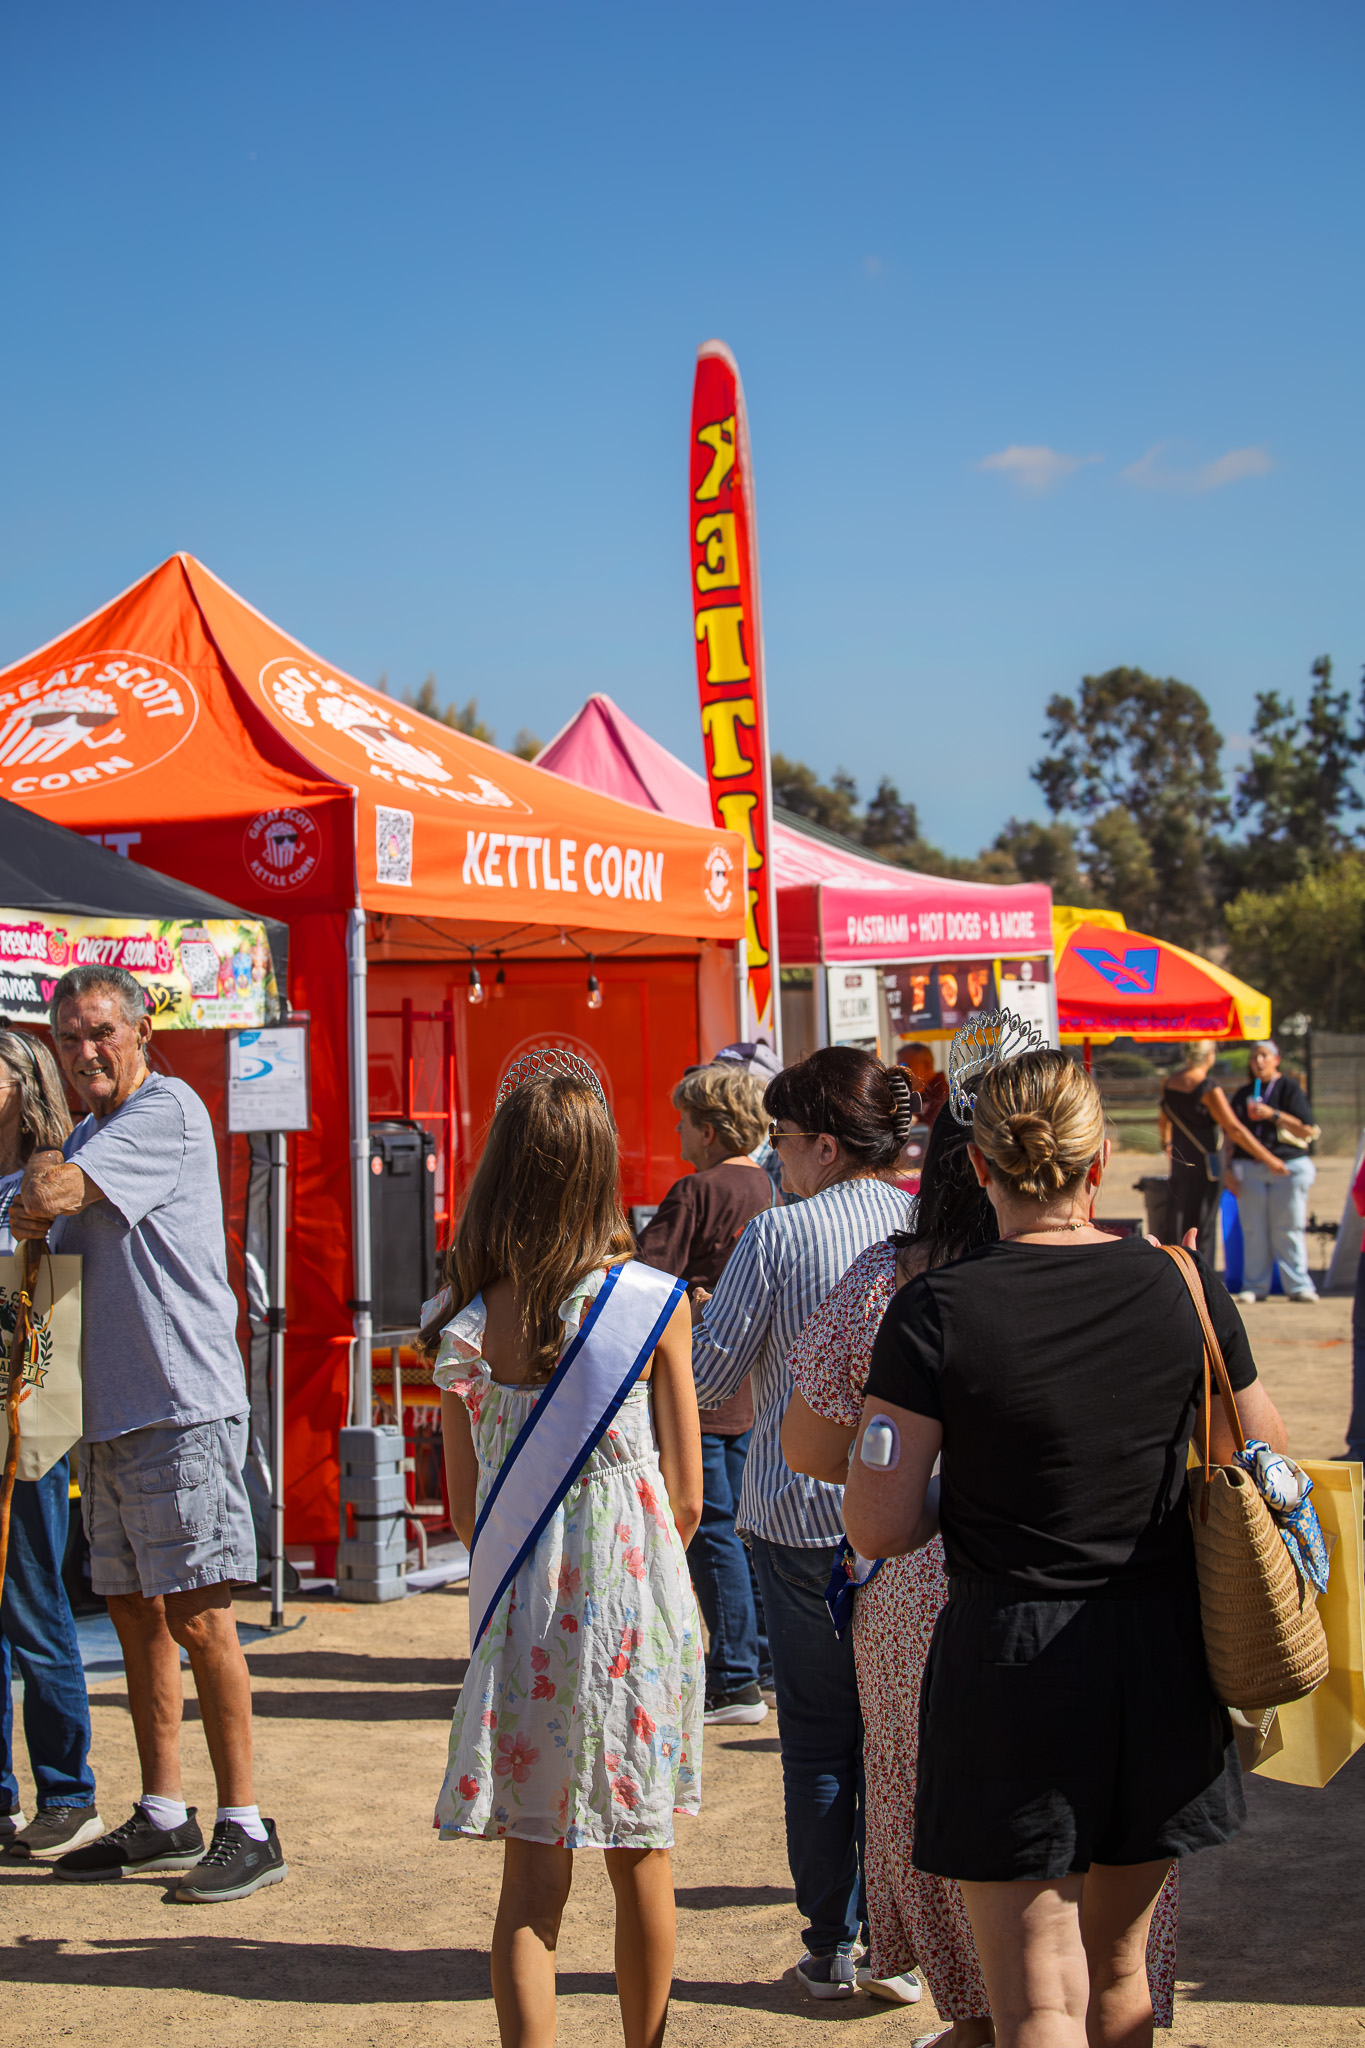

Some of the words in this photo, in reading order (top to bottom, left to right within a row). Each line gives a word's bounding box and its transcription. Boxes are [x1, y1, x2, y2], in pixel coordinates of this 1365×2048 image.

[0, 661, 95, 711] REAT
[94, 660, 184, 718] SCOTT
[11, 755, 134, 793] CORN
[248, 808, 280, 839] GREAT
[282, 807, 315, 834] SCOTT
[250, 859, 287, 887] KETTLE
[288, 855, 315, 884] CORN
[462, 830, 578, 892] KETTLE
[583, 843, 664, 902] CORN
[847, 914, 909, 945] PASTRAMI
[918, 912, 944, 942] HOT
[945, 911, 981, 941] DOGS
[1001, 910, 1036, 940] MORE
[0, 930, 47, 960] RESCAS
[77, 937, 123, 965] DIRTY
[120, 940, 157, 967] SODAS
[0, 977, 42, 1003] AVORS.
